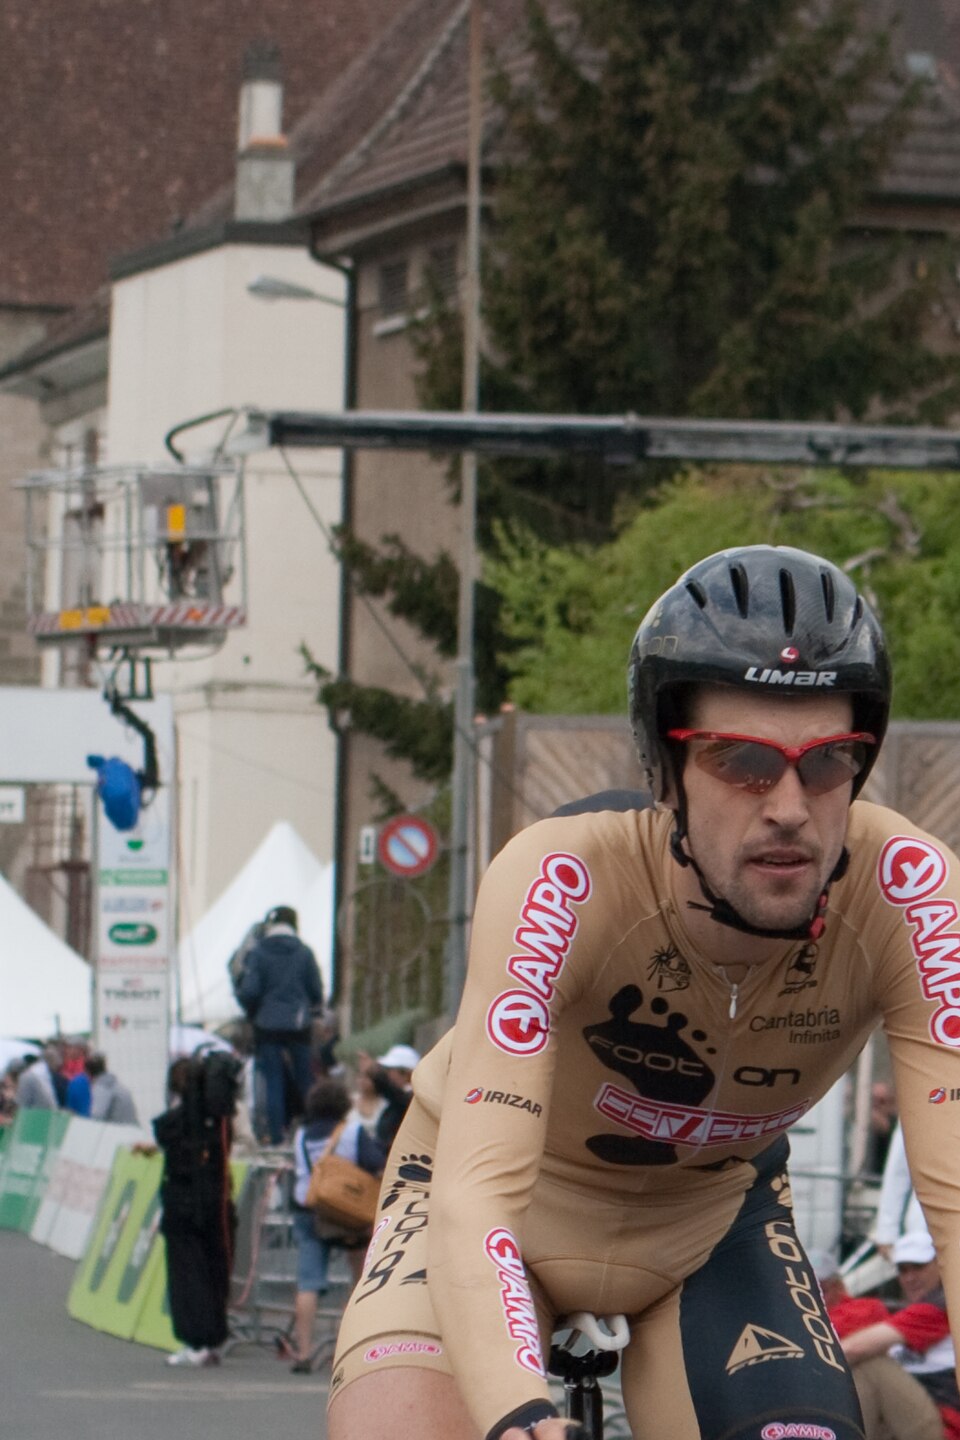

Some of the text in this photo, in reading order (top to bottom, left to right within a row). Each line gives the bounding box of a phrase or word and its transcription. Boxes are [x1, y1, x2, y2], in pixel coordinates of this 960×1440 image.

[749, 1004, 841, 1033] Cantabria
[788, 1028, 842, 1045] Infinita
[482, 1089, 544, 1119] IRIZAR
